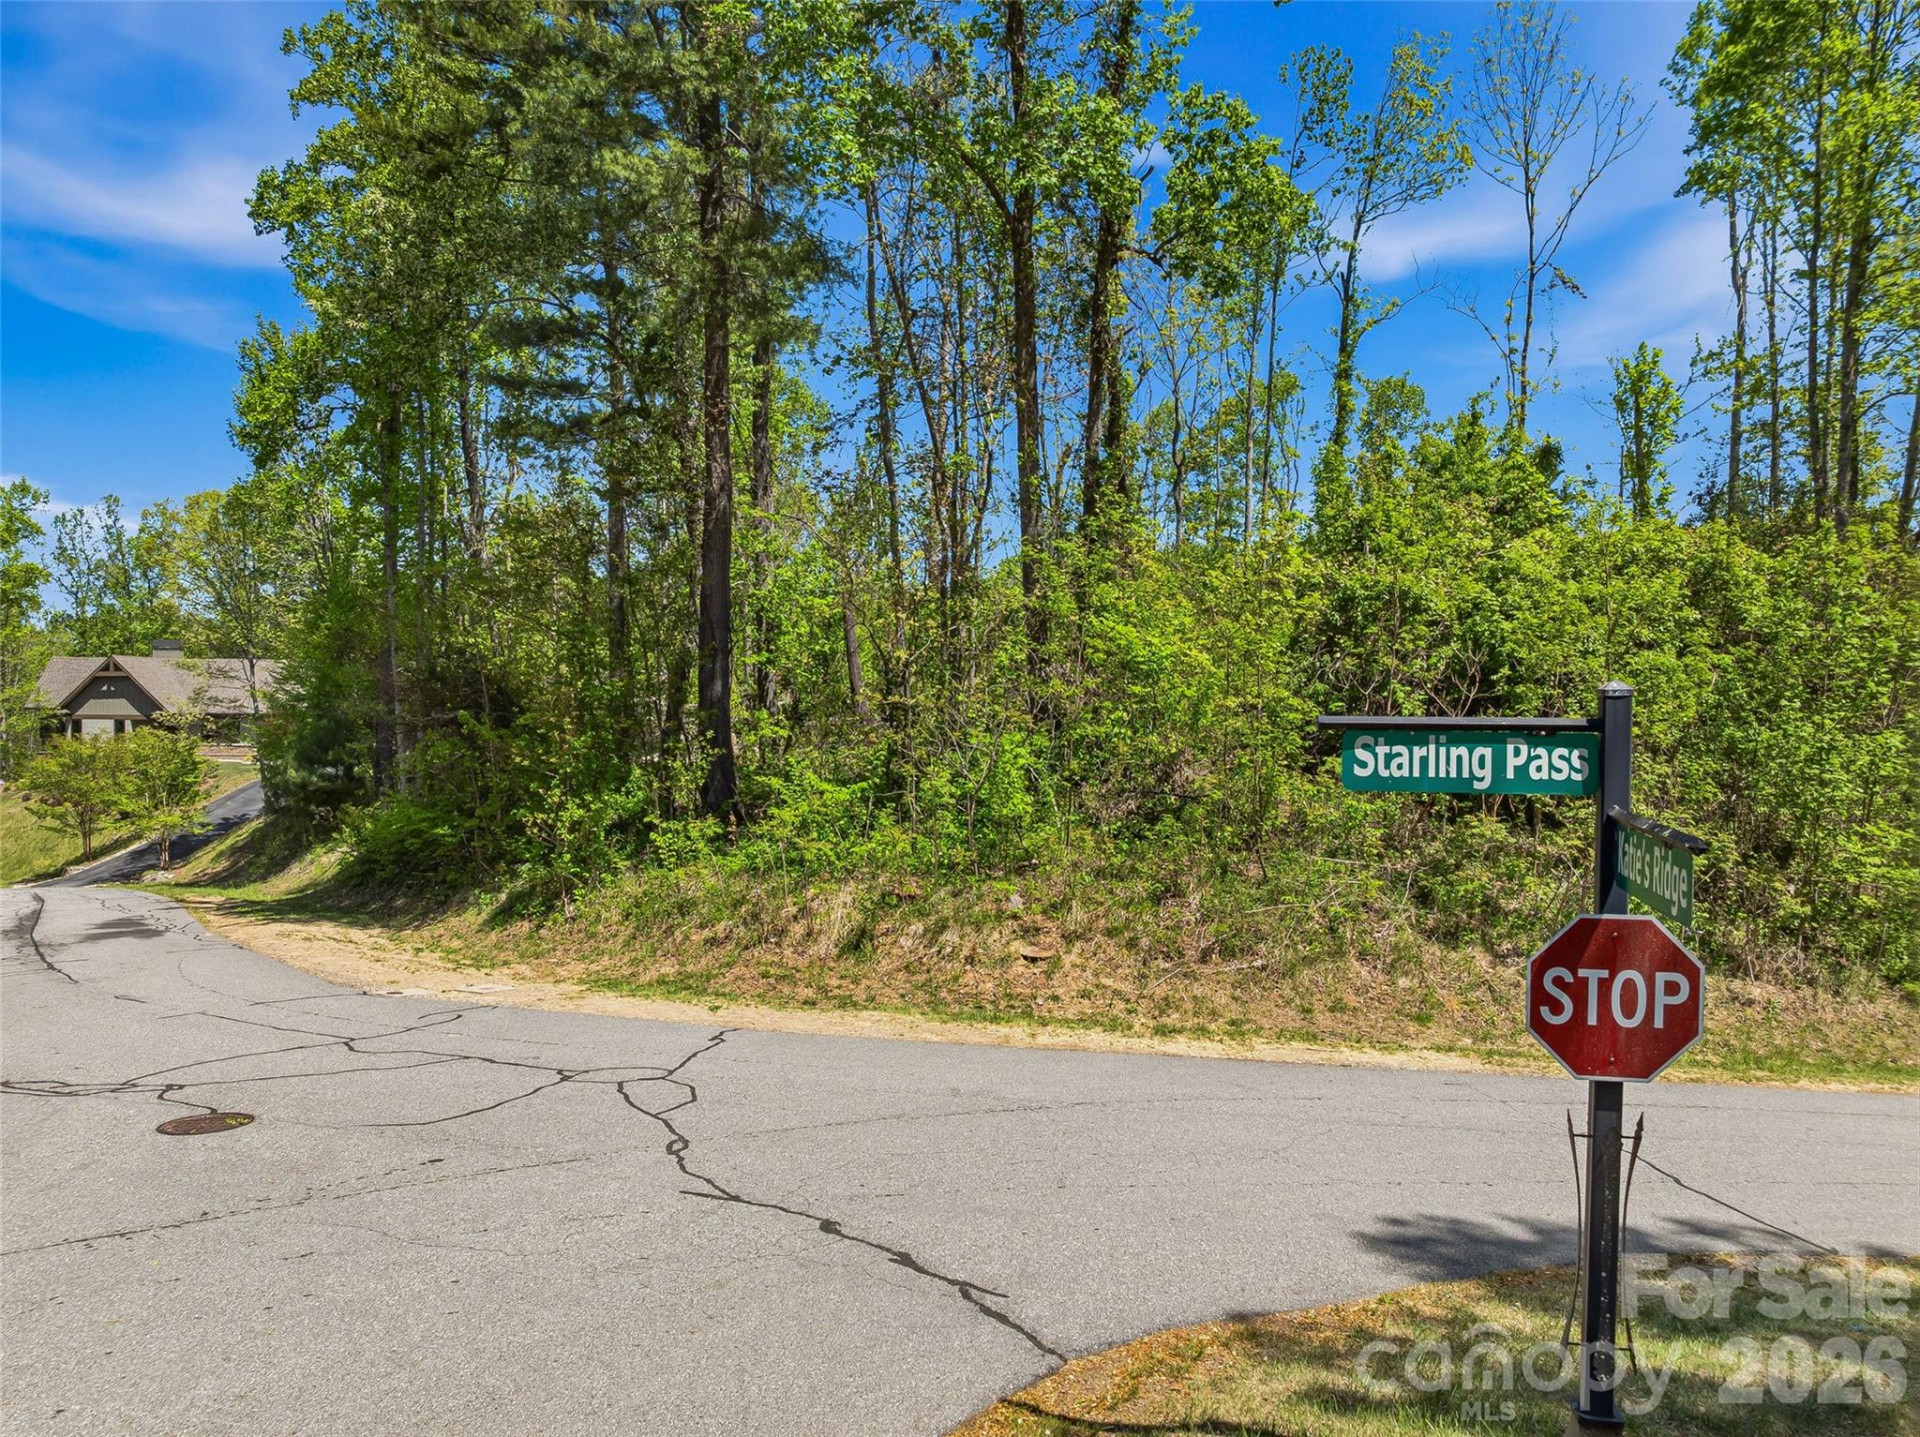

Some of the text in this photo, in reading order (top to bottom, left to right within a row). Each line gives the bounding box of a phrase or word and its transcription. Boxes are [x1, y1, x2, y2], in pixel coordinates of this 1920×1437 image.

[1352, 735, 1589, 790] Starling Pass
[1617, 830, 1688, 916] Katie's Ridge
[1539, 967, 1690, 1029] STOP
